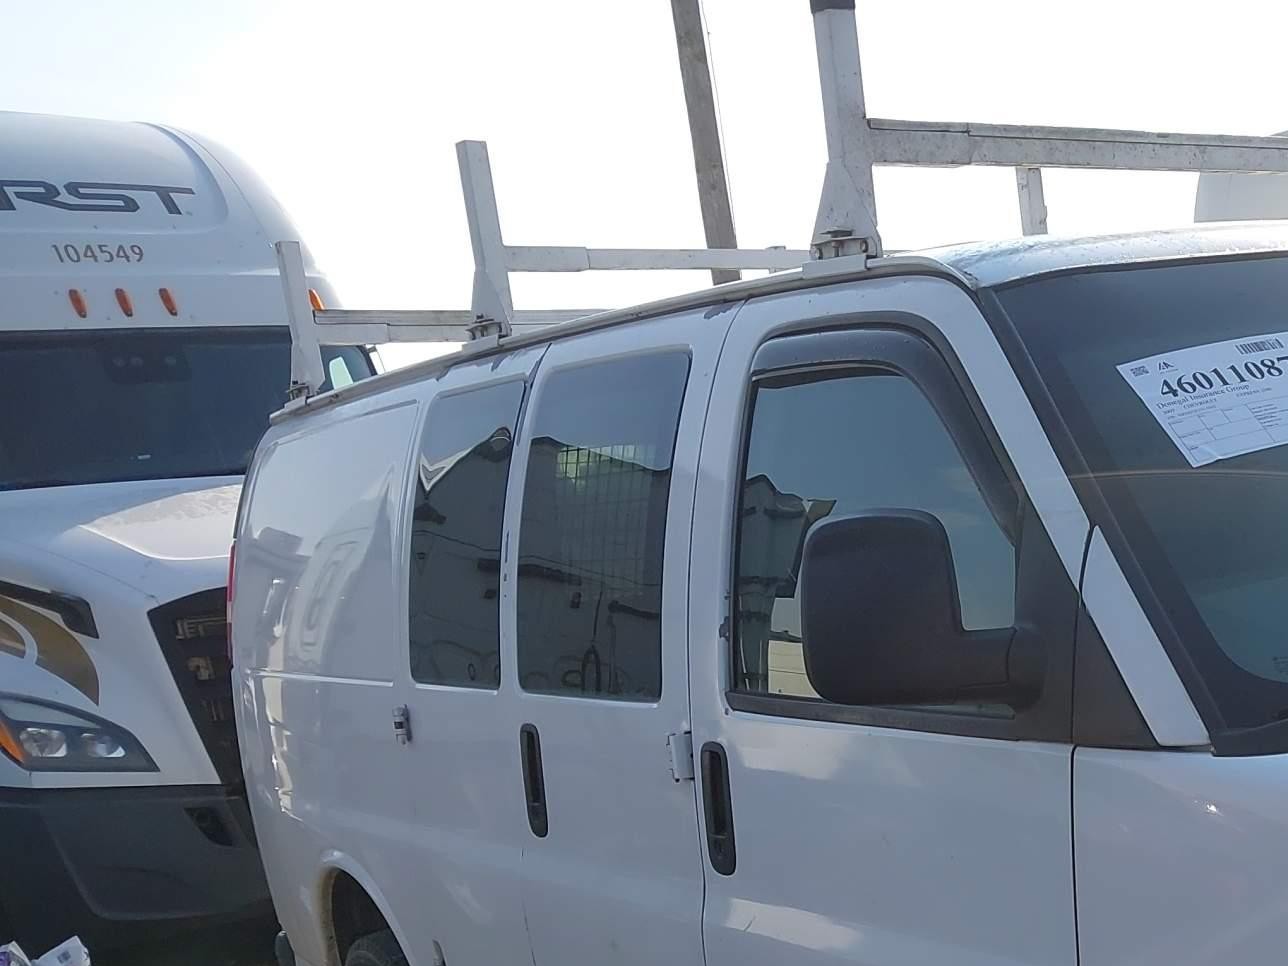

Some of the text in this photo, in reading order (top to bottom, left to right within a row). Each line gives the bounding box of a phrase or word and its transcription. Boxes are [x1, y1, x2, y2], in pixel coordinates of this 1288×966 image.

[51, 243, 145, 264] 104549
[1156, 396, 1189, 409] Donegal
[1190, 389, 1226, 402] Insurance
[1226, 383, 1250, 394] Group
